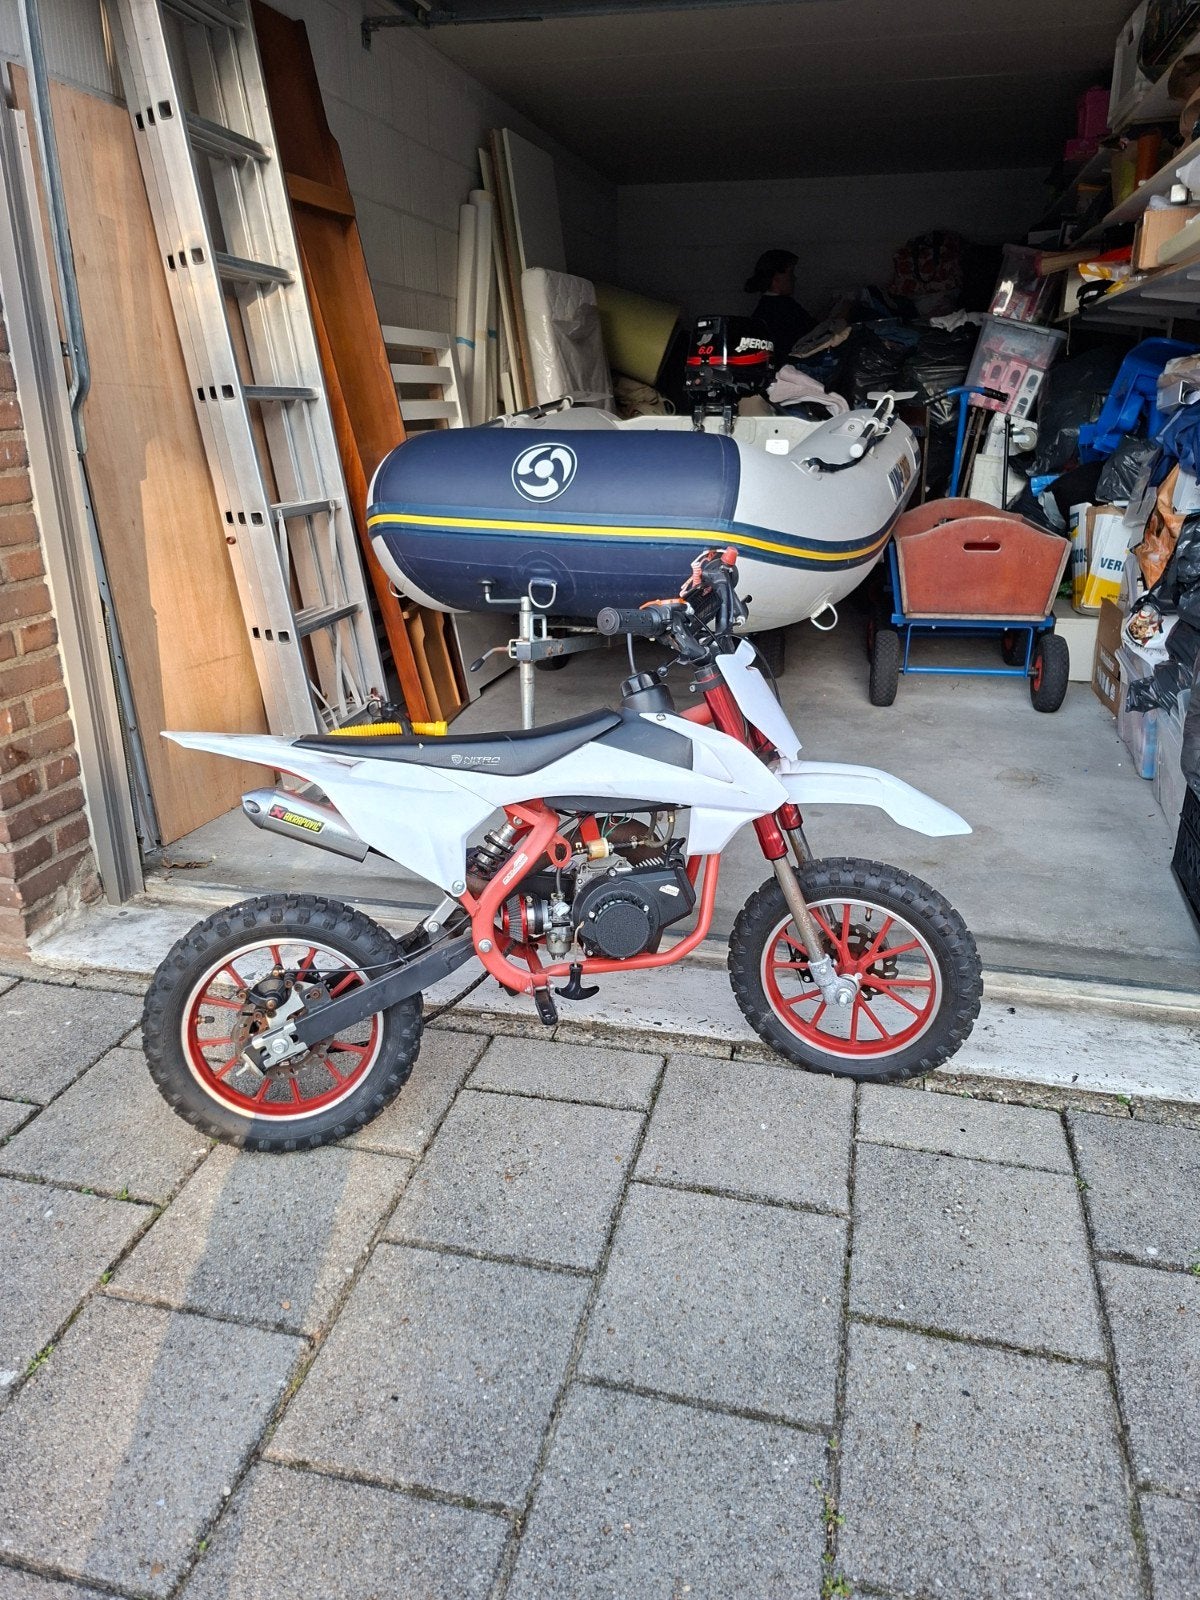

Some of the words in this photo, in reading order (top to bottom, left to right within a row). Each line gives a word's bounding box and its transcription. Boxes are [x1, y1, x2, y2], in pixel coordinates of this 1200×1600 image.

[698, 346, 714, 355] 6.0
[1100, 557, 1124, 572] VER
[463, 756, 501, 765] NITRO
